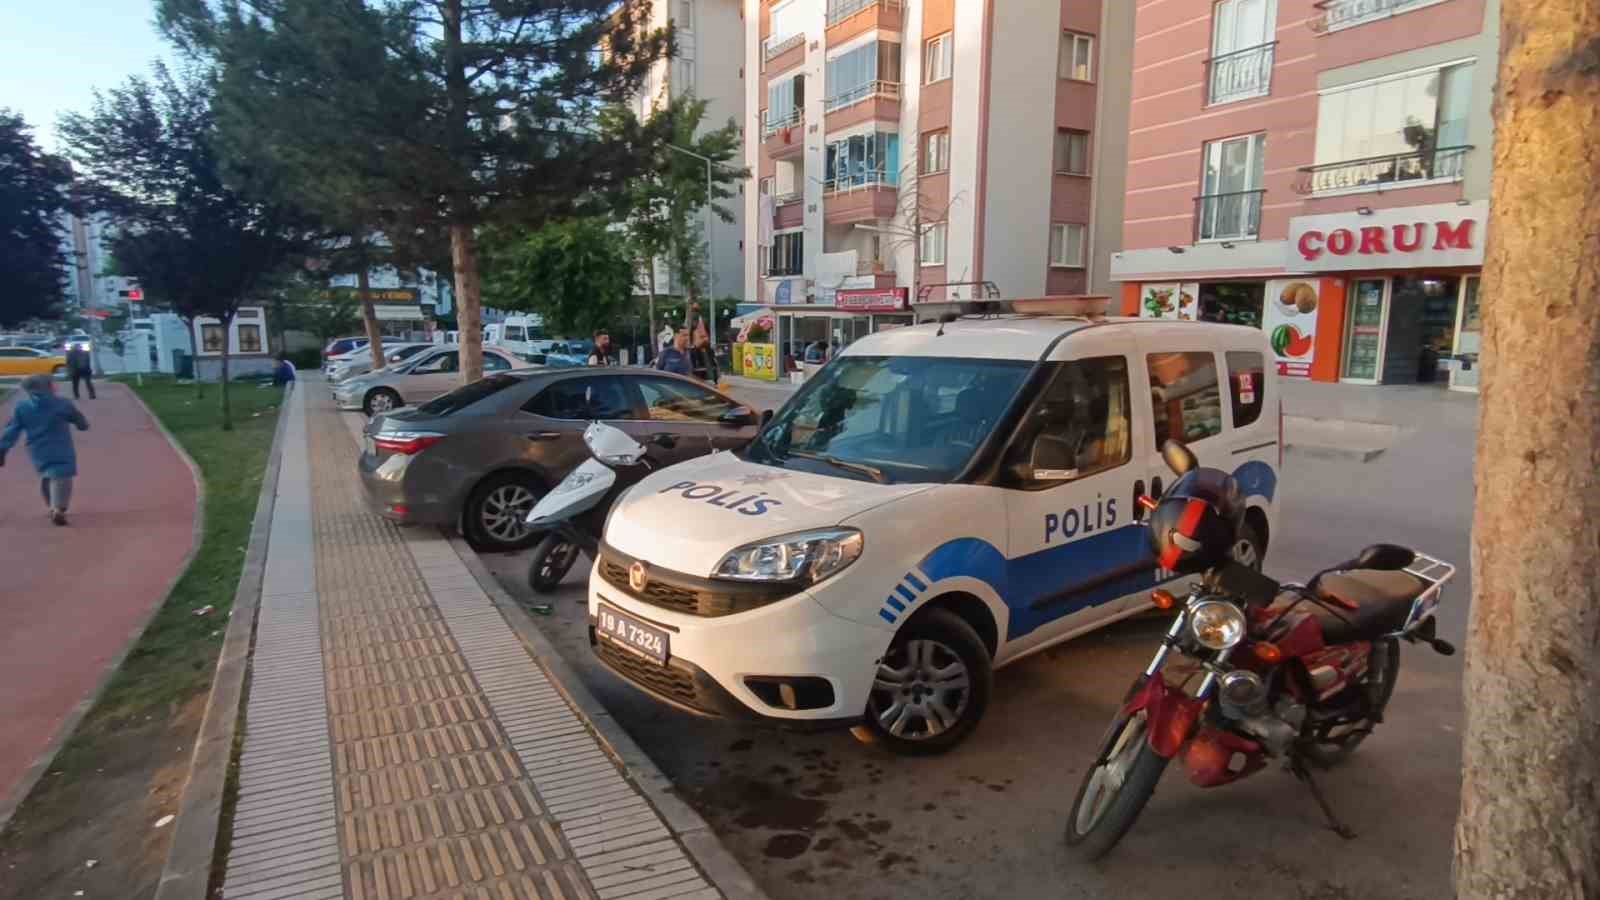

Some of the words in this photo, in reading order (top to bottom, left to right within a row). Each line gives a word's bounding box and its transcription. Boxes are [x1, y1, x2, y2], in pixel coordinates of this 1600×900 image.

[1298, 219, 1475, 261] ÇORUM
[658, 481, 782, 515] POLİS
[1044, 494, 1117, 543] POLİS
[617, 620, 626, 637] A
[629, 624, 662, 655] 7324
